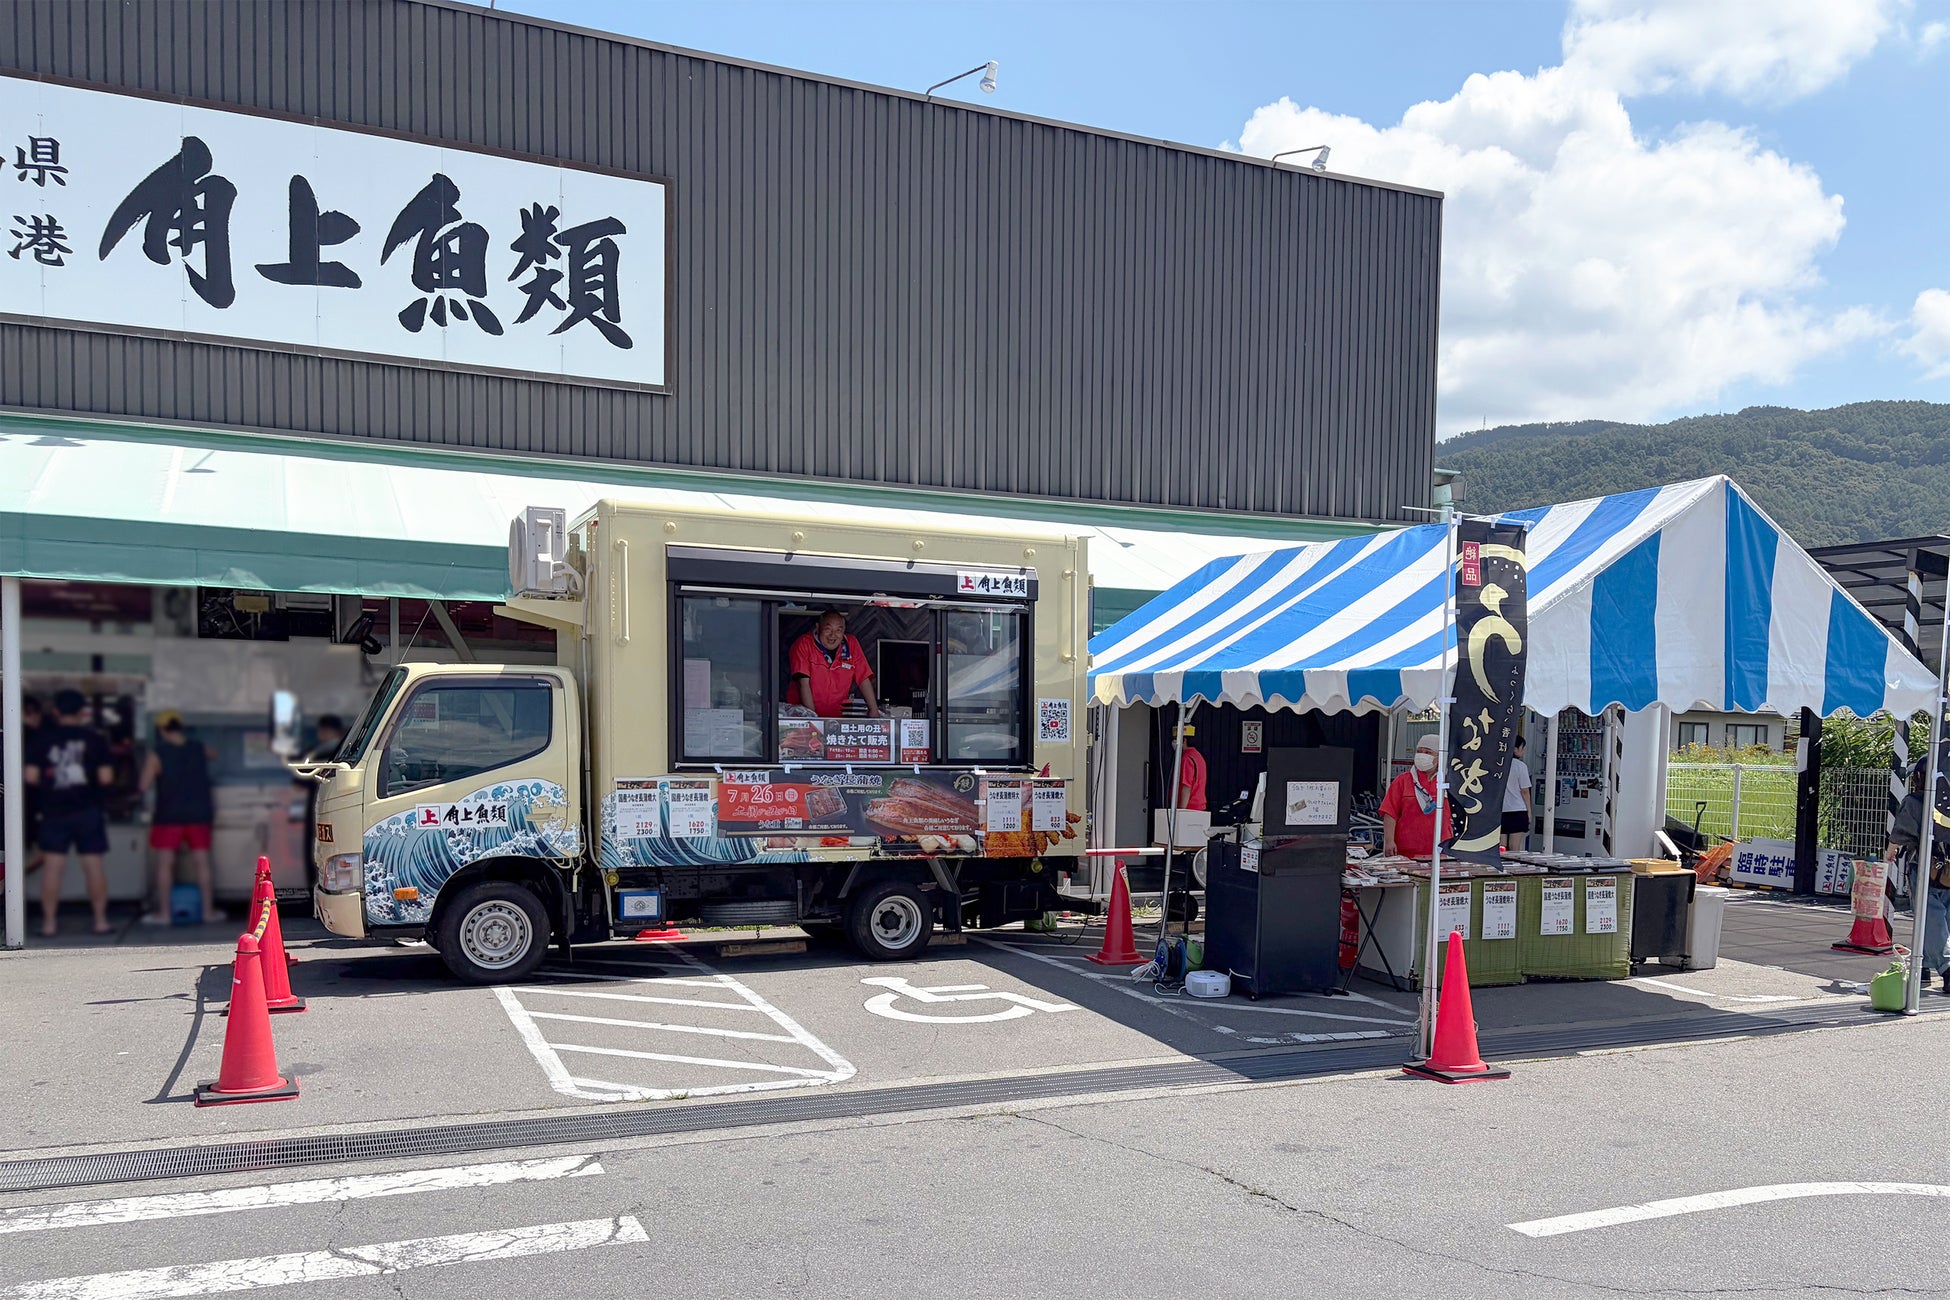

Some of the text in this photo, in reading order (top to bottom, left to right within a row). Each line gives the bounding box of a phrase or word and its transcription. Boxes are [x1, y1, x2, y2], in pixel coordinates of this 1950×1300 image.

[0, 135, 68, 187] 県
[99, 136, 633, 349] 角上魚類
[977, 574, 1026, 594] 角上魚類
[826, 734, 888, 746] 焼きたて販売
[737, 773, 768, 783] 角上魚類
[421, 804, 506, 825] 上 角上魚類
[1737, 852, 1797, 878] 臨時駐車
